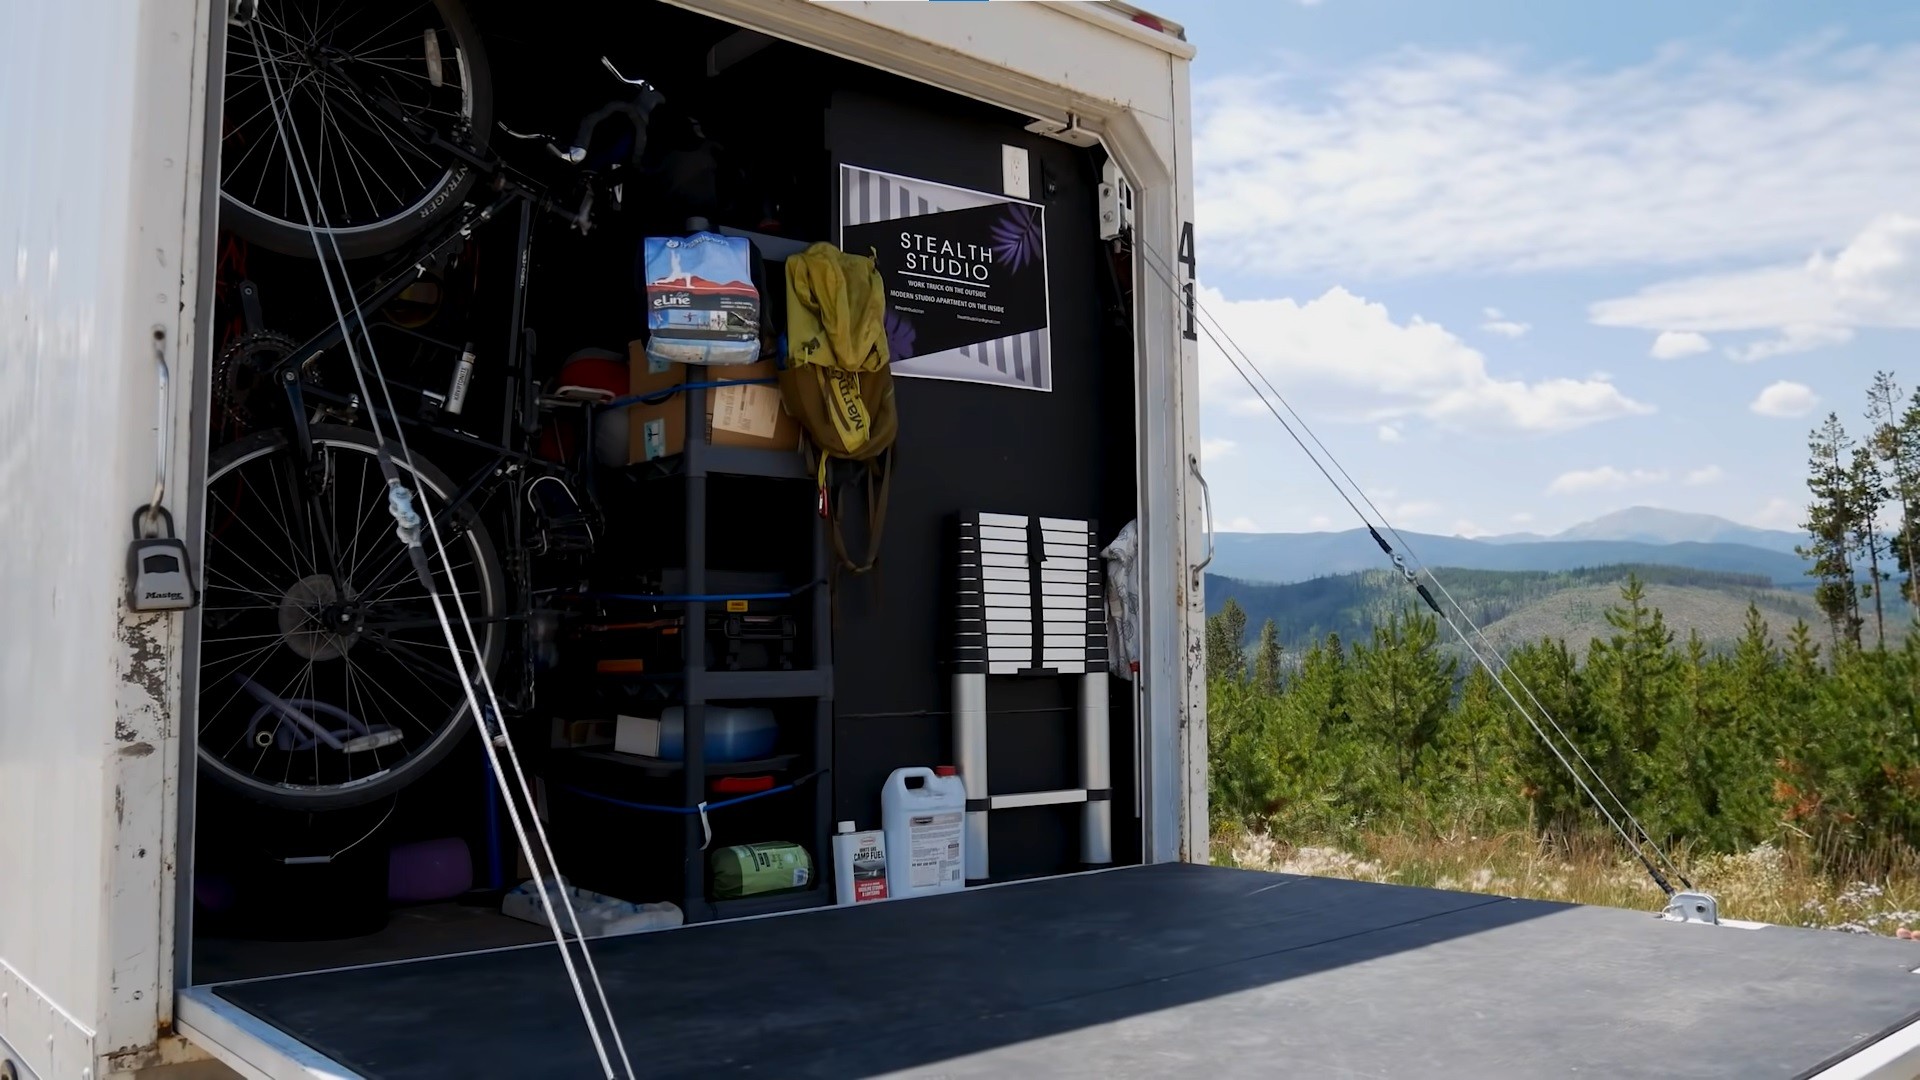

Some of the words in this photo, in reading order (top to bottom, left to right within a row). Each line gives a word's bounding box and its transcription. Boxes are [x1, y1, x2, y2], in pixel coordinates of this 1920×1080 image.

[419, 163, 469, 218] NTRAGER
[900, 232, 993, 263] STEALTH
[906, 252, 989, 281] STUDIO
[653, 294, 691, 306] eLine
[890, 289, 914, 299] MODERN
[914, 293, 936, 303] STUDIO
[936, 297, 968, 307] APARTMENT
[968, 301, 977, 309] ON
[977, 303, 987, 311] THE
[987, 305, 1005, 313] INSIDE
[908, 280, 926, 288] WORK
[926, 282, 944, 291] TRUCK
[964, 289, 987, 298] OUTSIDE
[830, 368, 864, 431] Marmo
[145, 591, 182, 599] Master
[854, 852, 869, 862] CAMP
[870, 850, 885, 860] FUEL
